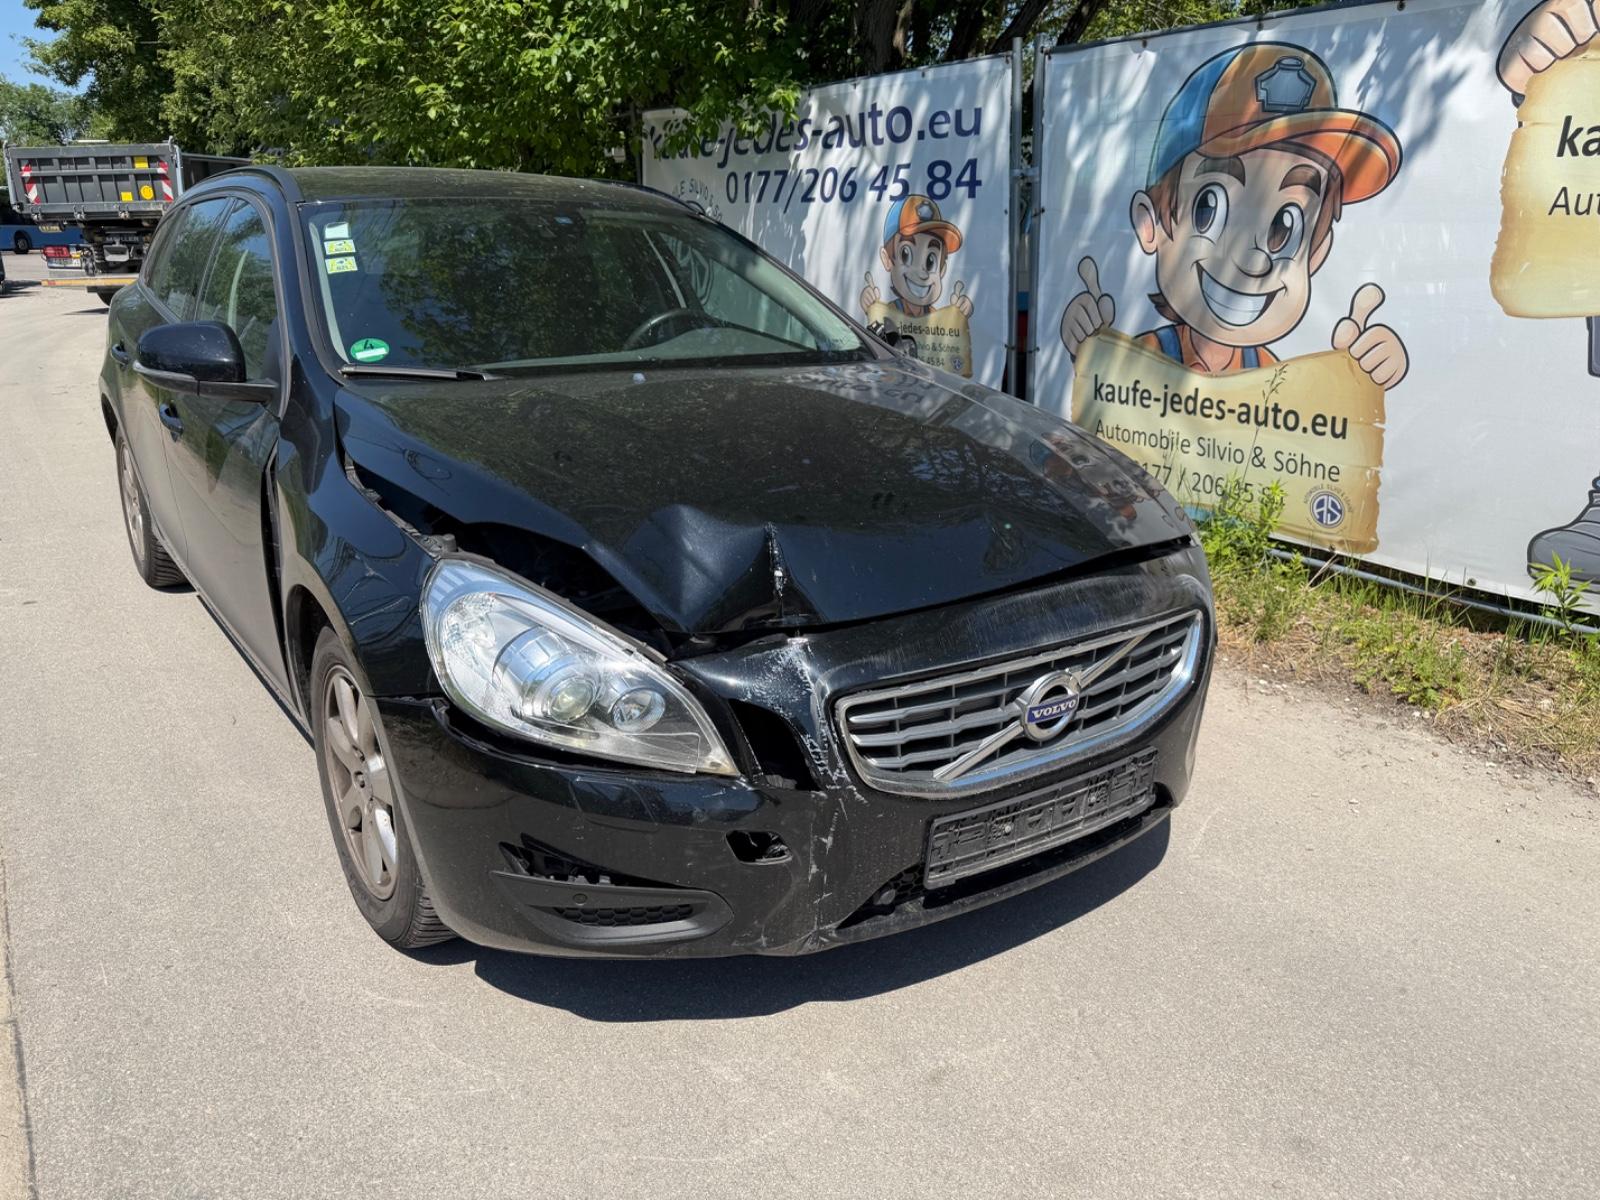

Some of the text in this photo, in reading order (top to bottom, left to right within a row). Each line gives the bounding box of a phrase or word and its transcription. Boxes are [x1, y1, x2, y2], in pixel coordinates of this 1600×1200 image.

[725, 166, 858, 214] 0177/206
[868, 163, 910, 202] 45
[925, 158, 983, 201] 84
[1093, 374, 1348, 441] kaufe-jedes-auto.eu
[1095, 419, 1341, 482] Automobile Silvio & Söhne
[1191, 472, 1225, 497] 206
[1031, 699, 1076, 718] VOLVO
